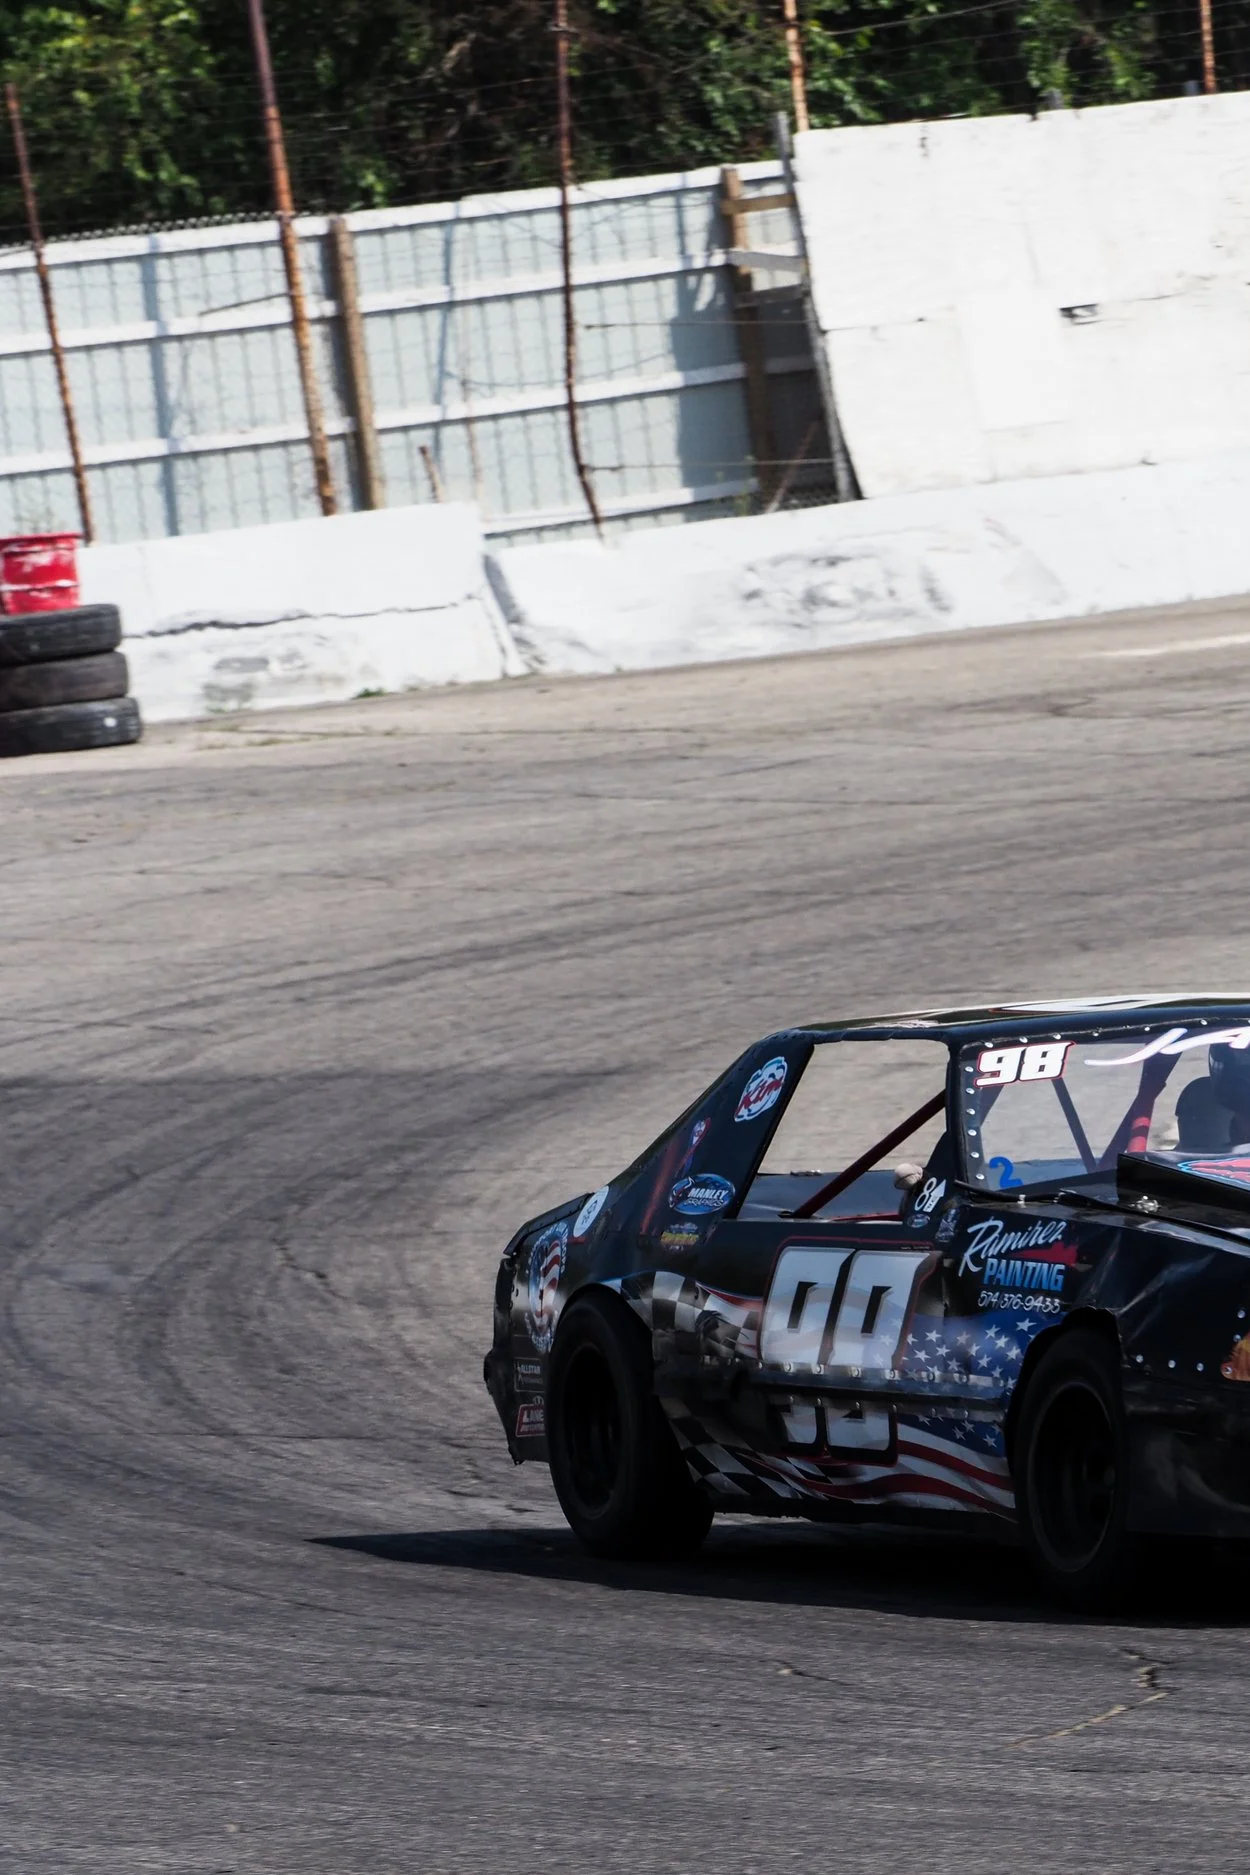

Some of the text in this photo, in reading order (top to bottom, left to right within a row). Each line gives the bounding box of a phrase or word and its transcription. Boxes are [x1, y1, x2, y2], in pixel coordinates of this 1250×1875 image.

[973, 1041, 1077, 1087] 98
[988, 1156, 1023, 1190] 2
[687, 1187, 729, 1200] MANLEY
[958, 1216, 1067, 1277] Ramirez
[983, 1257, 1066, 1292] PAINTING
